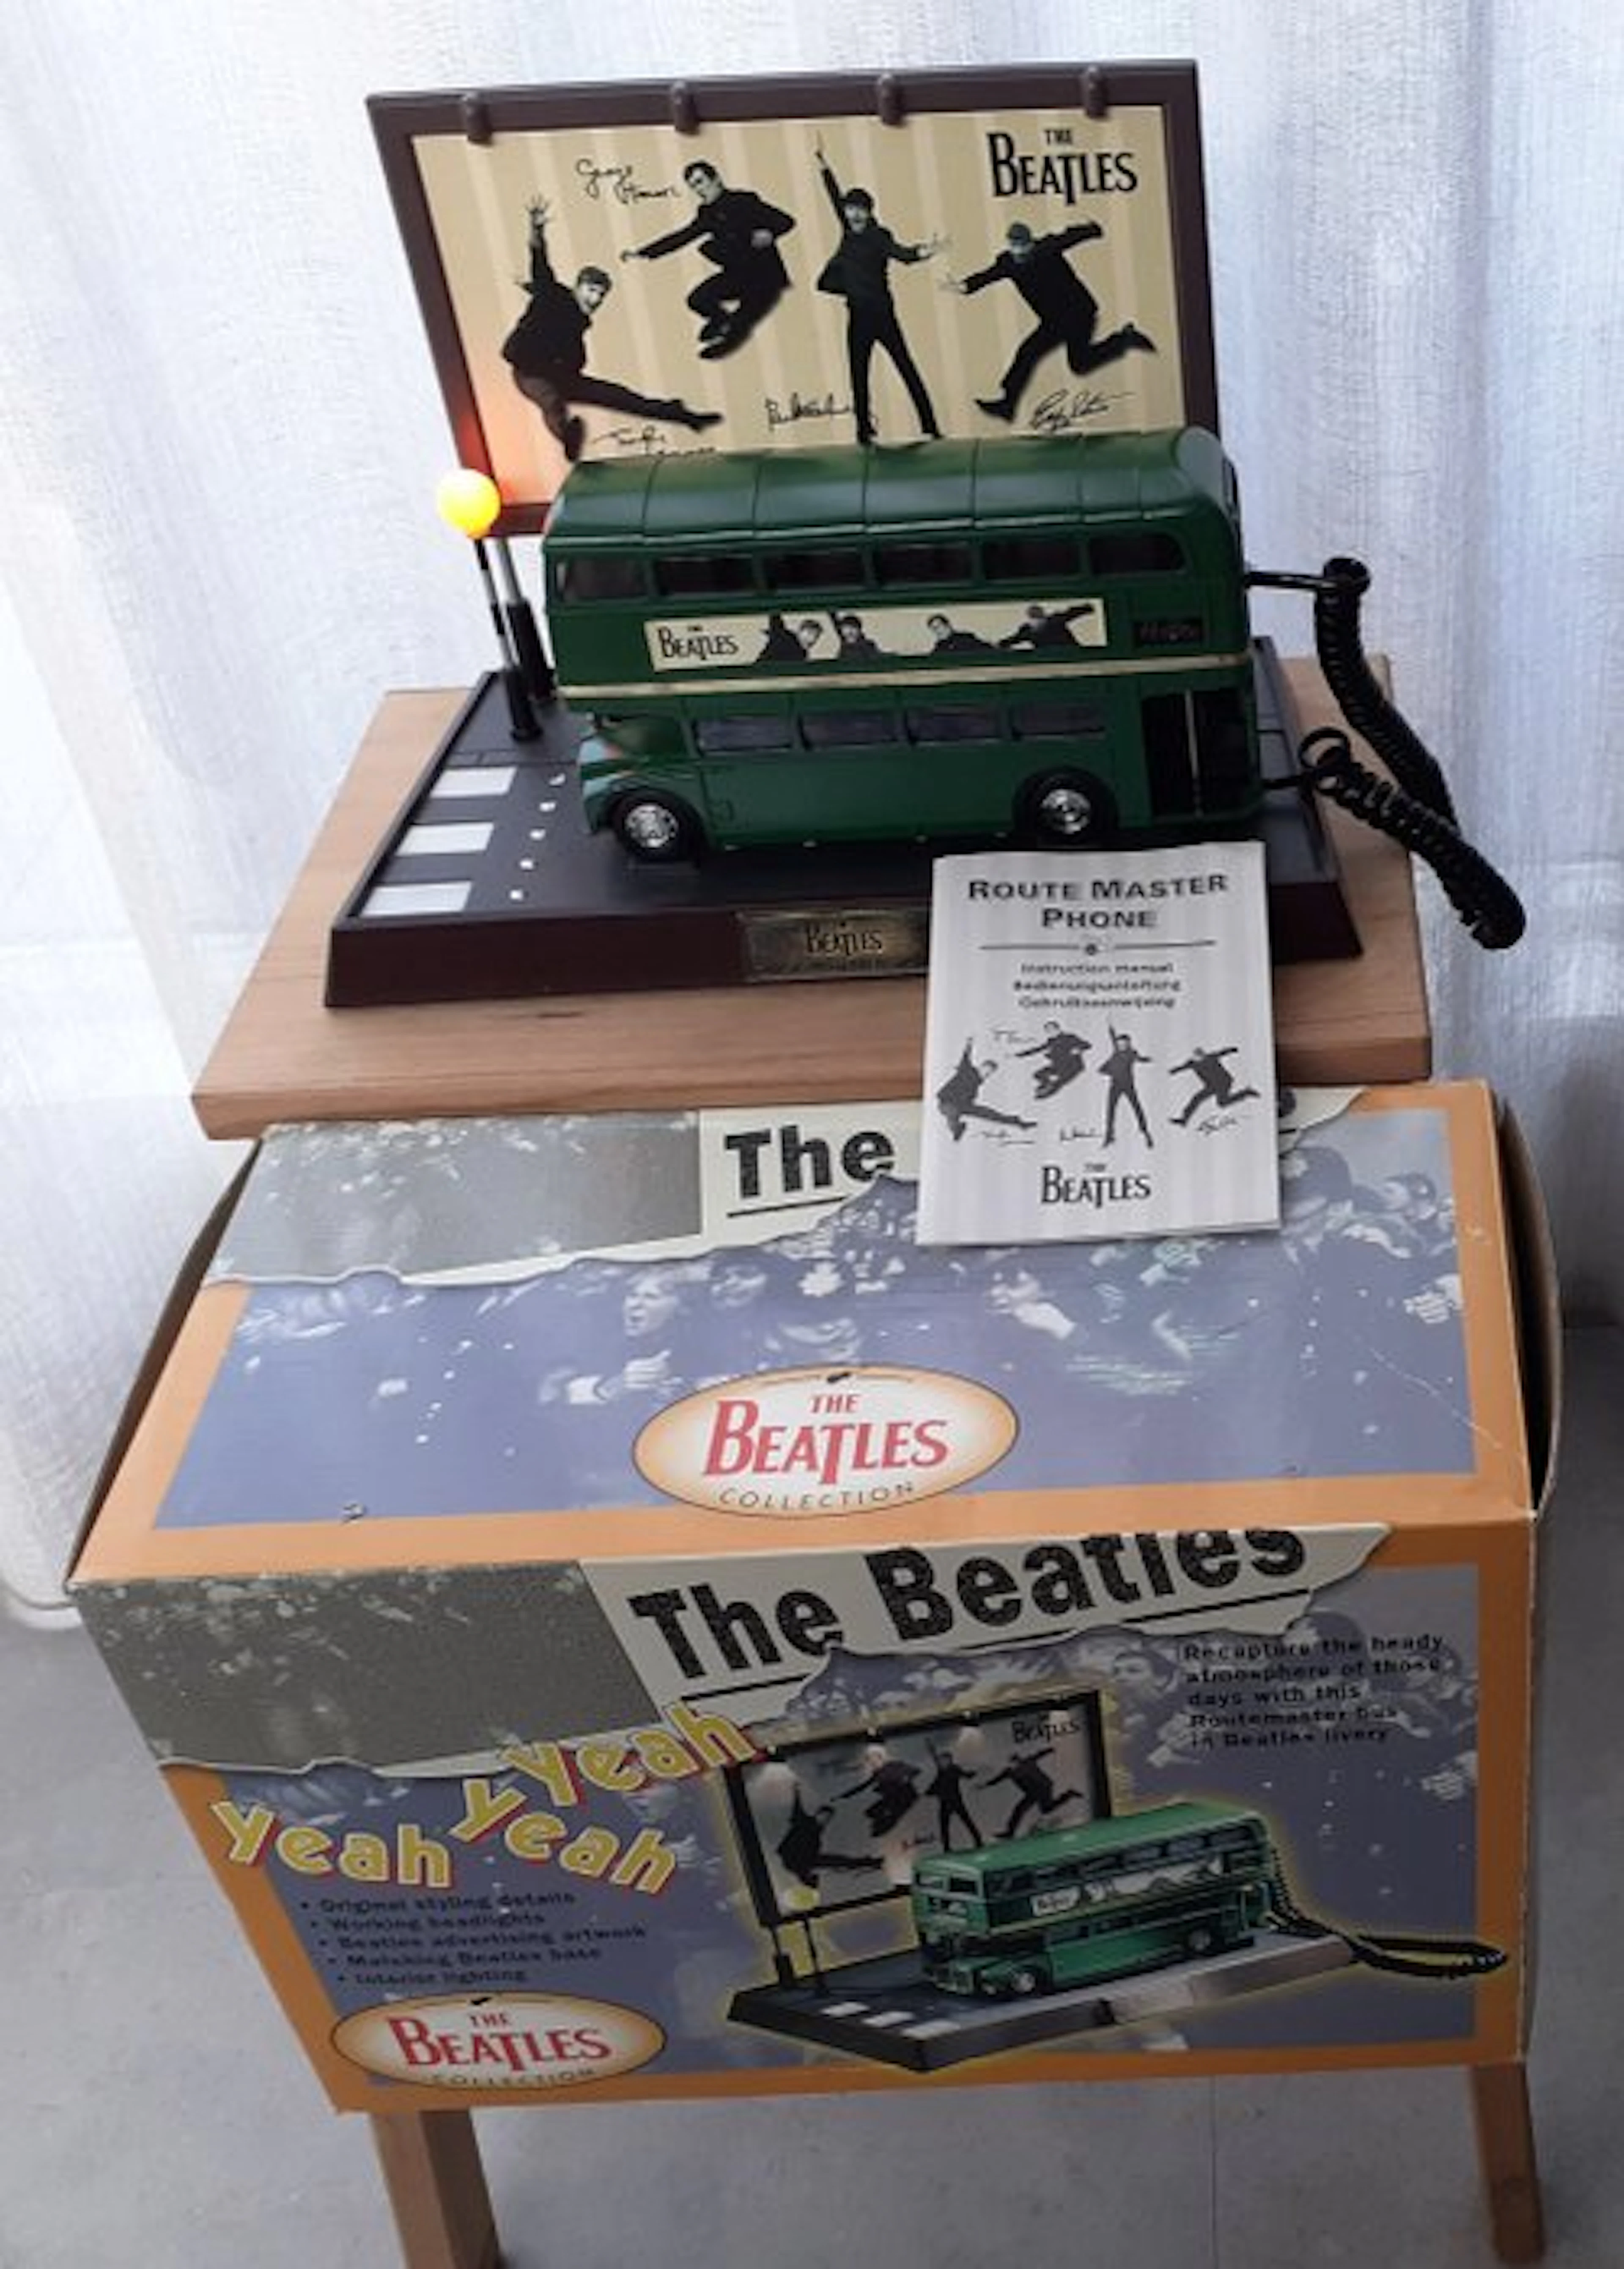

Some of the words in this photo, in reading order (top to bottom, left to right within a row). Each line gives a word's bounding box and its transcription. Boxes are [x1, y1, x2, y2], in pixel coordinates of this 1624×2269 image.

[1044, 129, 1073, 145] THE
[987, 132, 1138, 205] BEATLES
[658, 626, 739, 660] BEATLES
[969, 879, 1081, 900] ROUTE
[1092, 874, 1227, 900] MASTER
[1042, 908, 1157, 928] PHONE
[1021, 963, 1112, 974] Instruction
[724, 1124, 895, 1198] The
[1041, 1165, 1151, 1208] BEATLES
[809, 1393, 861, 1414] THE
[703, 1399, 951, 1486] BEATLES
[718, 1482, 915, 1512] COLLECTION
[626, 1583, 843, 1679] The
[864, 1529, 1306, 1640] Beatles
[1185, 1643, 1310, 1660] Recapture
[1322, 1637, 1361, 1654] the
[1372, 1633, 1443, 1651] heady
[1375, 1658, 1439, 1674] those
[1188, 1691, 1242, 1709] days
[1254, 1687, 1305, 1703] with
[1316, 1685, 1361, 1701] this
[469, 2013, 511, 2028] THE
[387, 2016, 612, 2071] BEATLES
